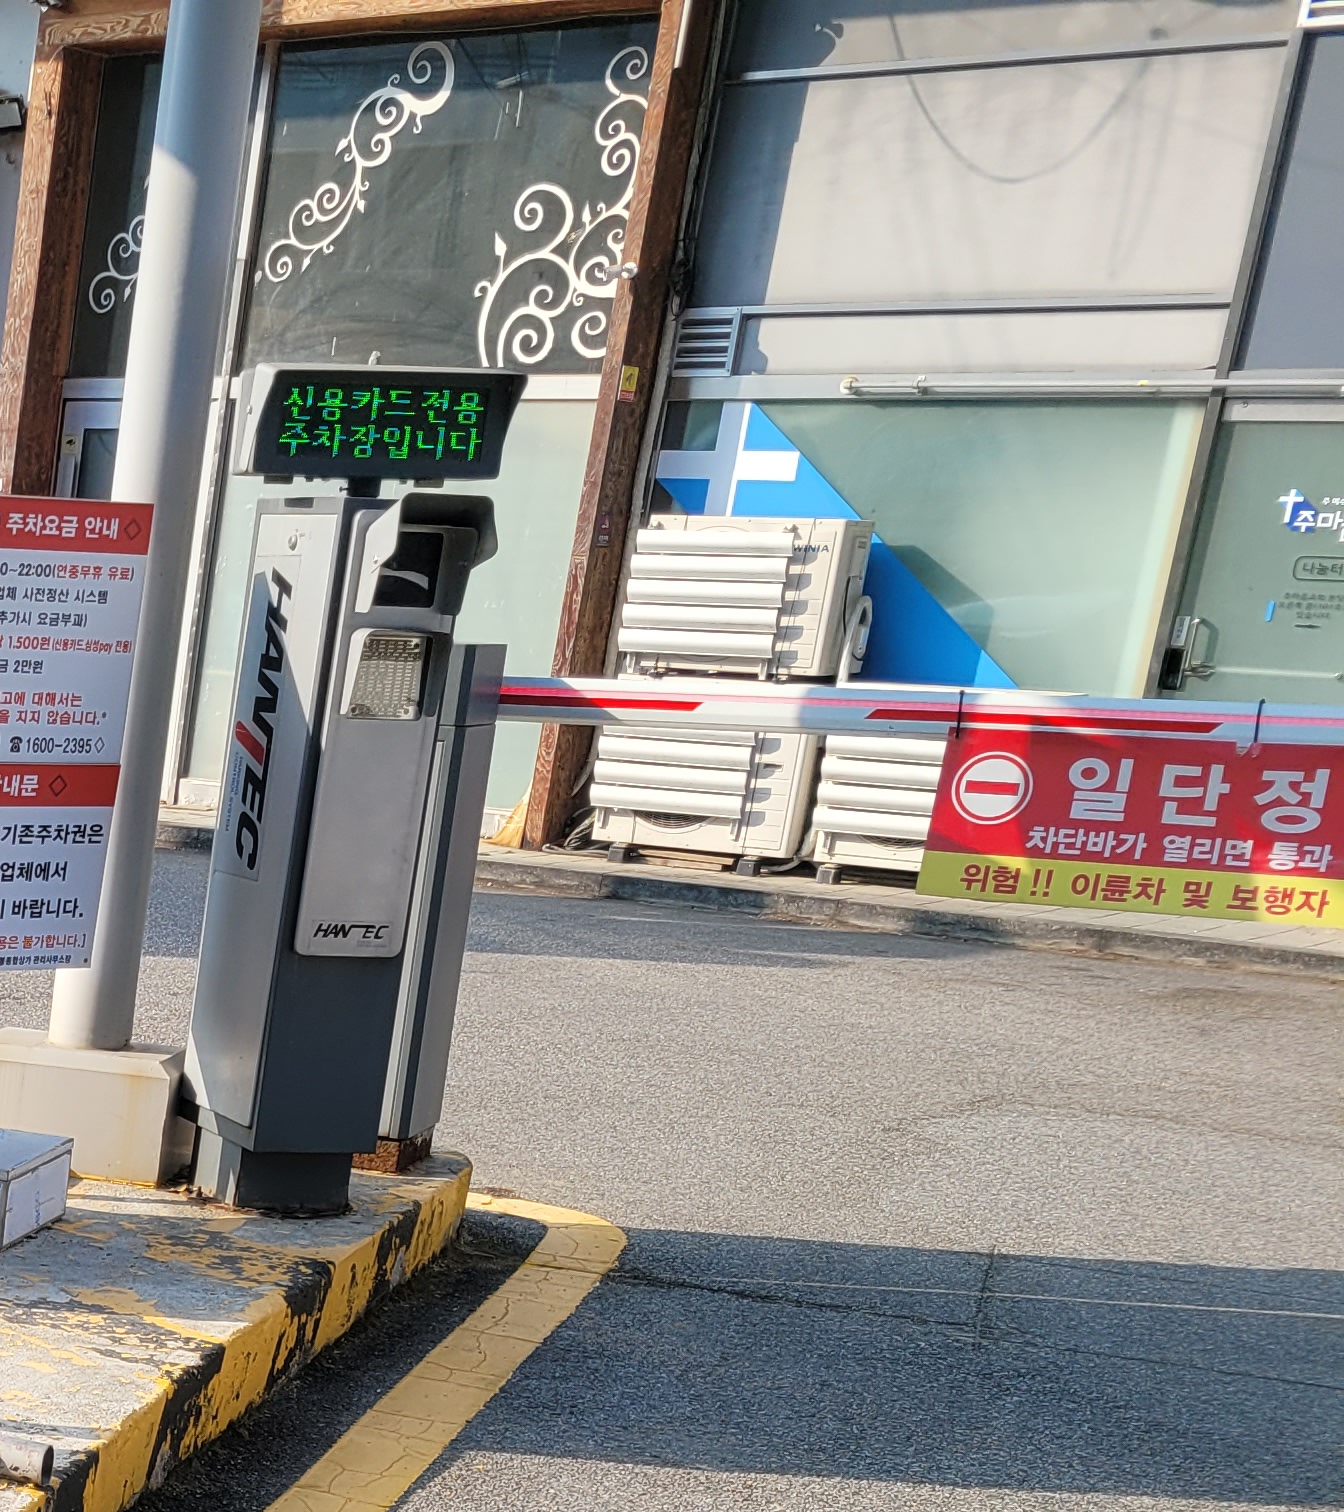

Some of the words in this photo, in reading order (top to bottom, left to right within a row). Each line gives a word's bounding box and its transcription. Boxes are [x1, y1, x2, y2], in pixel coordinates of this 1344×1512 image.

[278, 422, 483, 462] 주차장입니다
[6, 512, 79, 538] 주차요금
[84, 517, 119, 540] 안내
[1293, 510, 1344, 543] 주마
[793, 544, 831, 553] WINIA
[22, 587, 70, 603] 사전정산
[73, 589, 109, 604] 시스템
[13, 659, 44, 674] 2만원
[31, 691, 83, 707] 대해서는
[16, 710, 41, 724] 지지
[0, 823, 104, 845] 기존주차권은
[1025, 826, 1148, 860] 차단바가
[1162, 834, 1253, 867] 열리면
[1268, 841, 1334, 874] 통과
[1070, 872, 1167, 906] 이륜차
[1182, 880, 1213, 910] 및
[1226, 883, 1330, 919] 보행자
[11, 897, 84, 919] 바랍니다.
[313, 923, 390, 940] HANTEC
